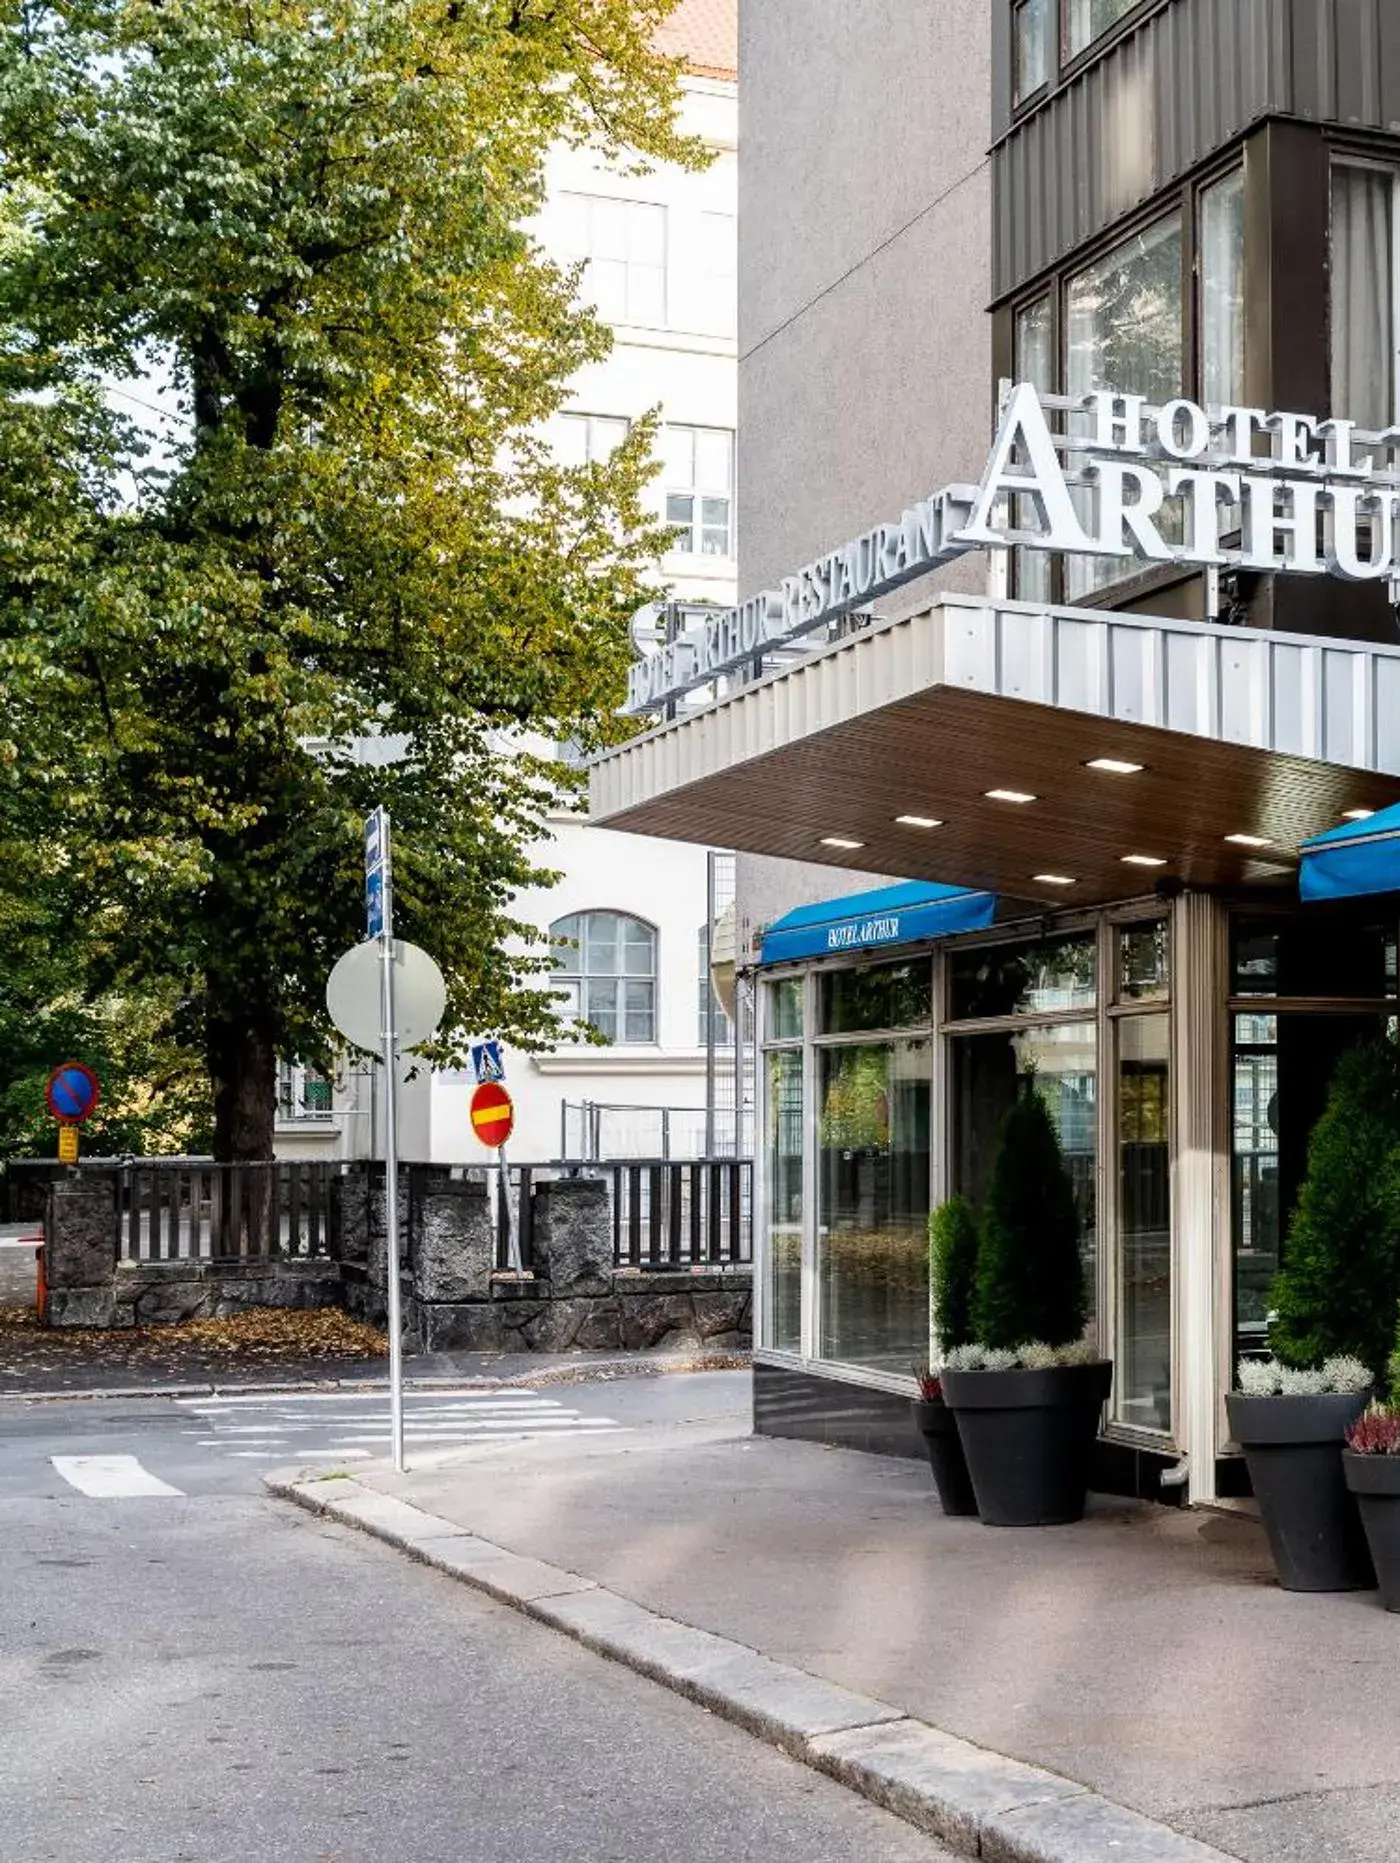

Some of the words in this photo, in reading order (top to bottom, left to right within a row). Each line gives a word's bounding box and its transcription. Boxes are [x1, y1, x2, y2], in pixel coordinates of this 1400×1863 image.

[1082, 391, 1375, 478] HOTEL
[828, 924, 858, 947] HOTEL
[860, 917, 899, 942] ARTHUR
